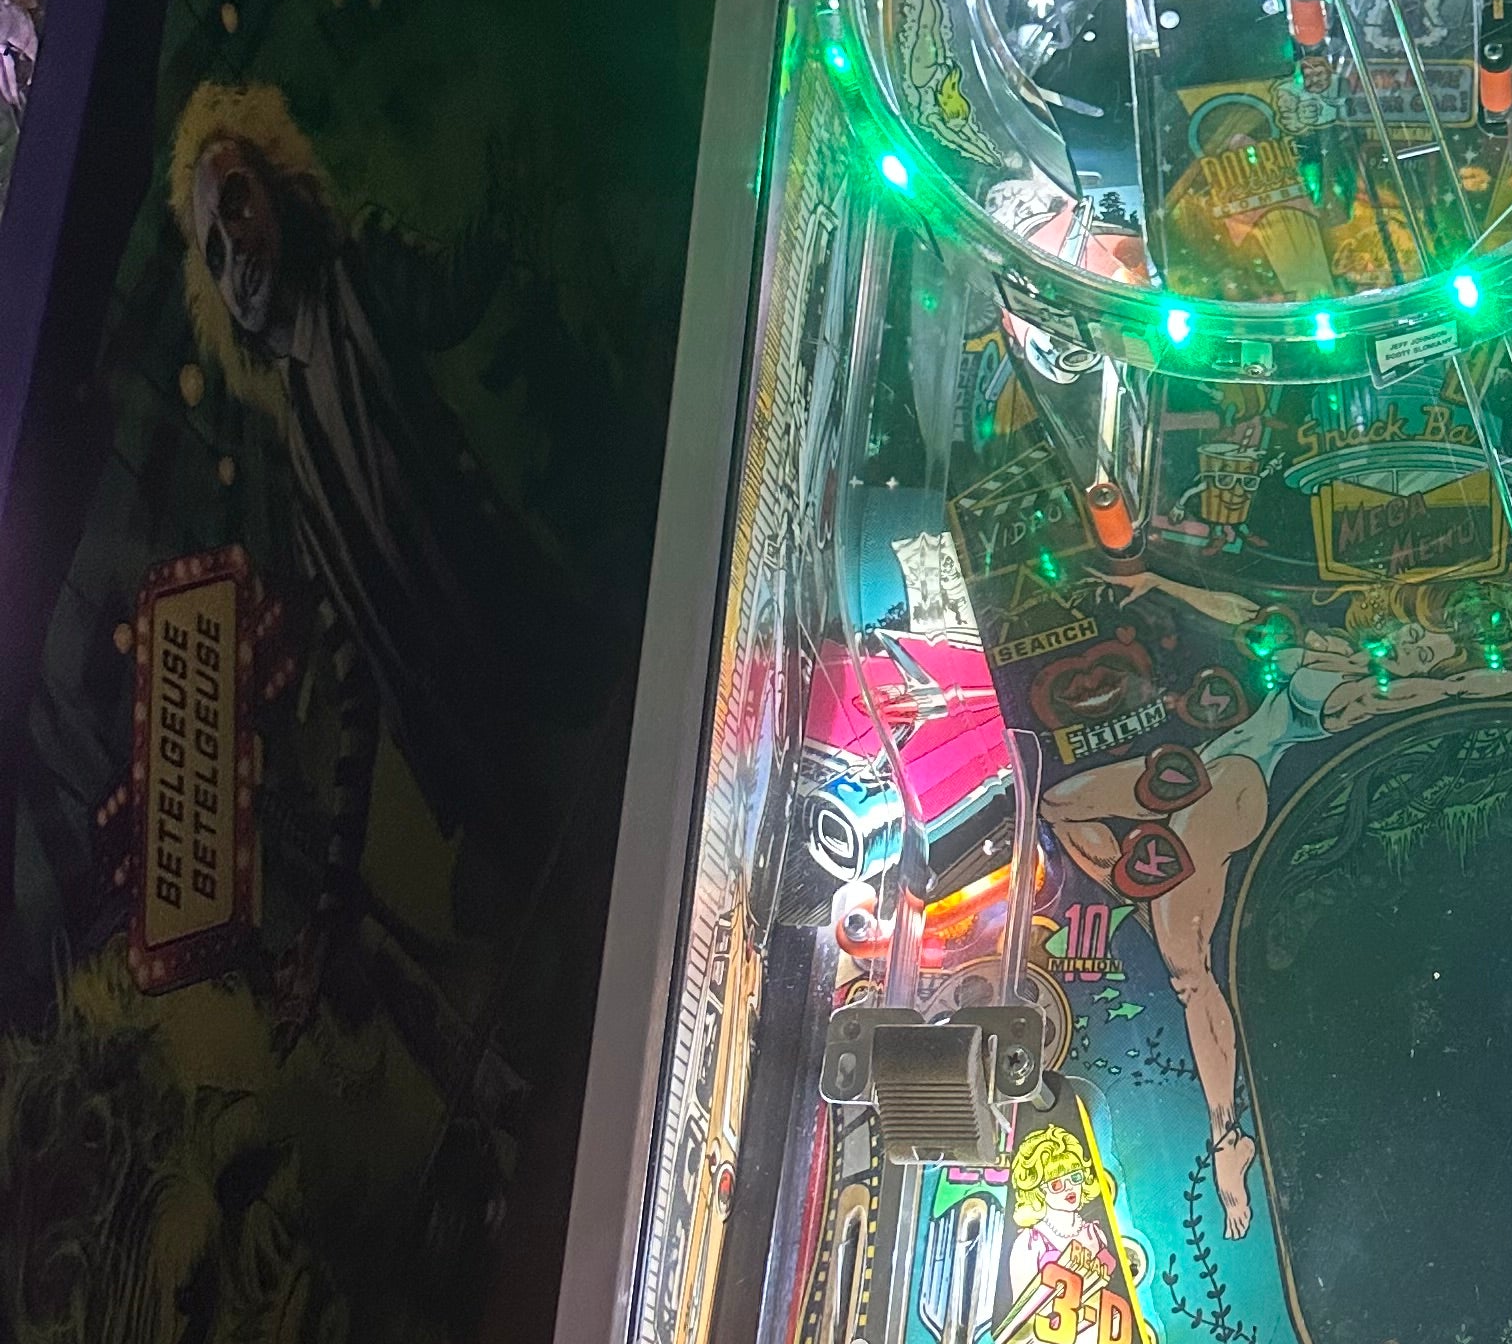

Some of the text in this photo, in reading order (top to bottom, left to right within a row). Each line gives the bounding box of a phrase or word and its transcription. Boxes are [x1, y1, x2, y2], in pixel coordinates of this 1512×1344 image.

[1415, 405, 1481, 445] Ba
[1338, 490, 1427, 553] MEGA
[1386, 521, 1476, 578] MENU
[997, 620, 1097, 663] SEARCH
[192, 615, 222, 902] BETELGEUSE
[1053, 700, 1168, 765] FILM
[156, 620, 190, 910] BETELGEUSE
[1049, 958, 1123, 973] MILLION
[1064, 903, 1111, 982] 10
[1069, 1240, 1111, 1280] REAL
